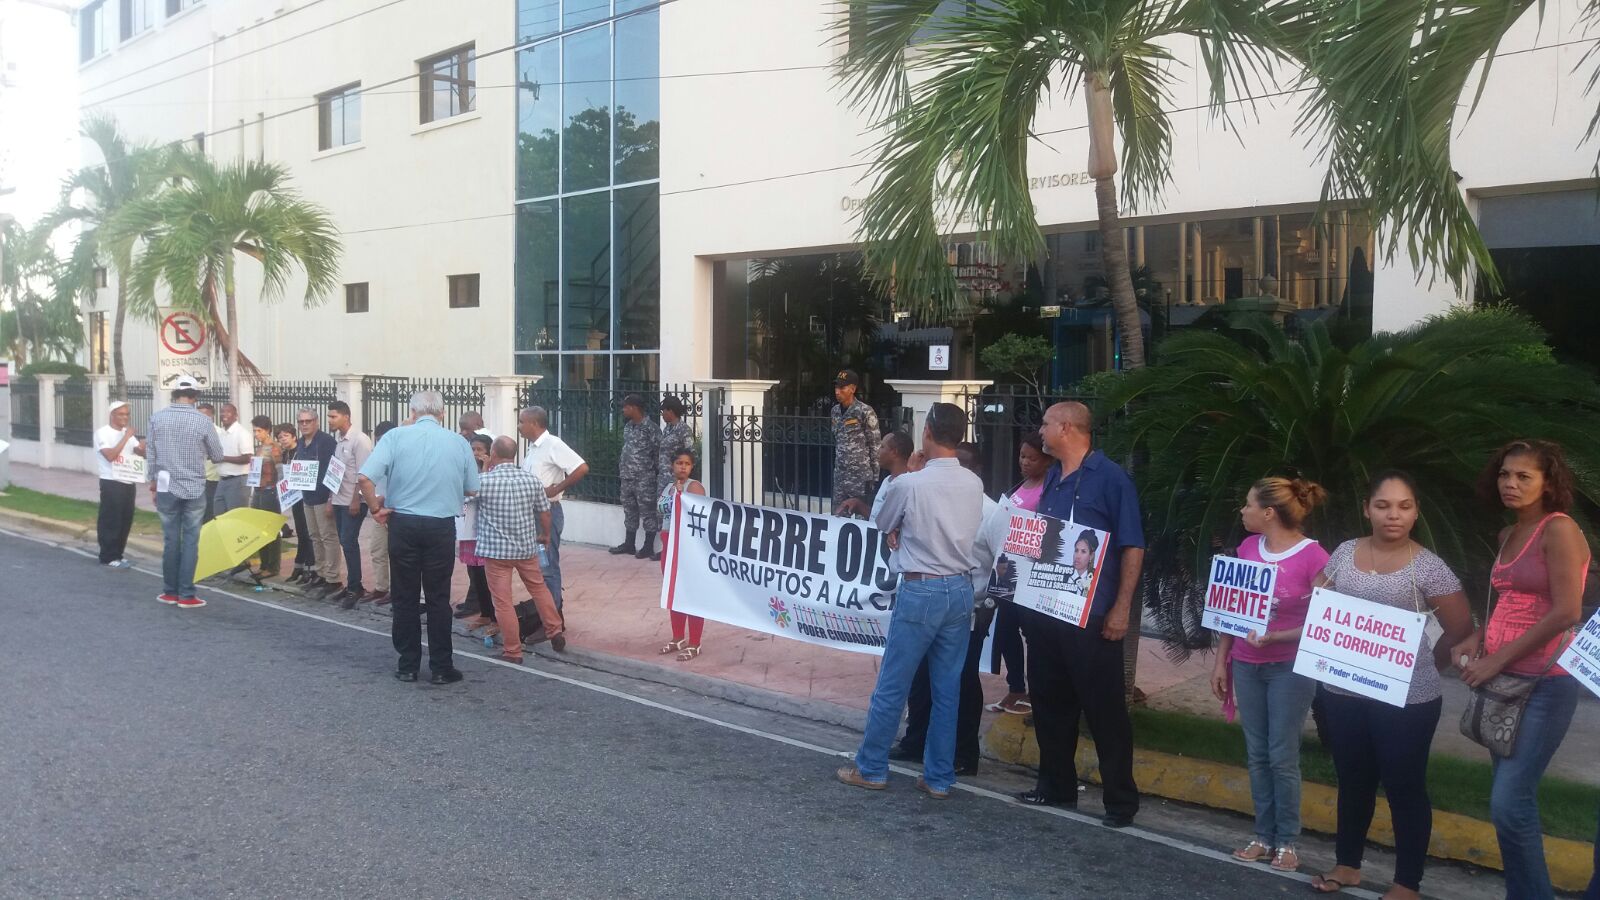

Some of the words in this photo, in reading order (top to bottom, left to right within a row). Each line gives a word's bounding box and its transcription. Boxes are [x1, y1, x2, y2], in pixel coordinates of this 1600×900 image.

[1031, 171, 1096, 190] RVISORE
[161, 358, 170, 367] NO
[172, 357, 208, 367] ESTACIONE
[291, 462, 301, 473] NO
[1009, 515, 1023, 530] NO
[687, 500, 829, 575] #CIERRE
[836, 522, 898, 591] OIS
[1007, 530, 1042, 547] JUECES
[1003, 542, 1043, 559] CORRUPTOS
[1055, 562, 1074, 575] Reyes
[1213, 559, 1272, 593] DANILO
[708, 552, 812, 599] CORRUPTOS
[816, 580, 830, 605] A
[836, 584, 864, 611] LA
[1038, 572, 1064, 582] CONDUCTA
[1046, 580, 1053, 588] LA
[1042, 605, 1059, 615] PUEBLO
[1208, 584, 1269, 620] MIENTE
[1220, 619, 1234, 629] Poder
[1322, 606, 1332, 622] A
[1335, 609, 1351, 628] LA
[797, 621, 827, 641] PODER
[826, 628, 886, 649] CIUDADANO
[1306, 624, 1330, 643] LOS
[1333, 632, 1415, 668] CORRUPTOS
[1576, 637, 1584, 646] A
[1581, 639, 1592, 652] LA
[1328, 665, 1351, 679] Poder
